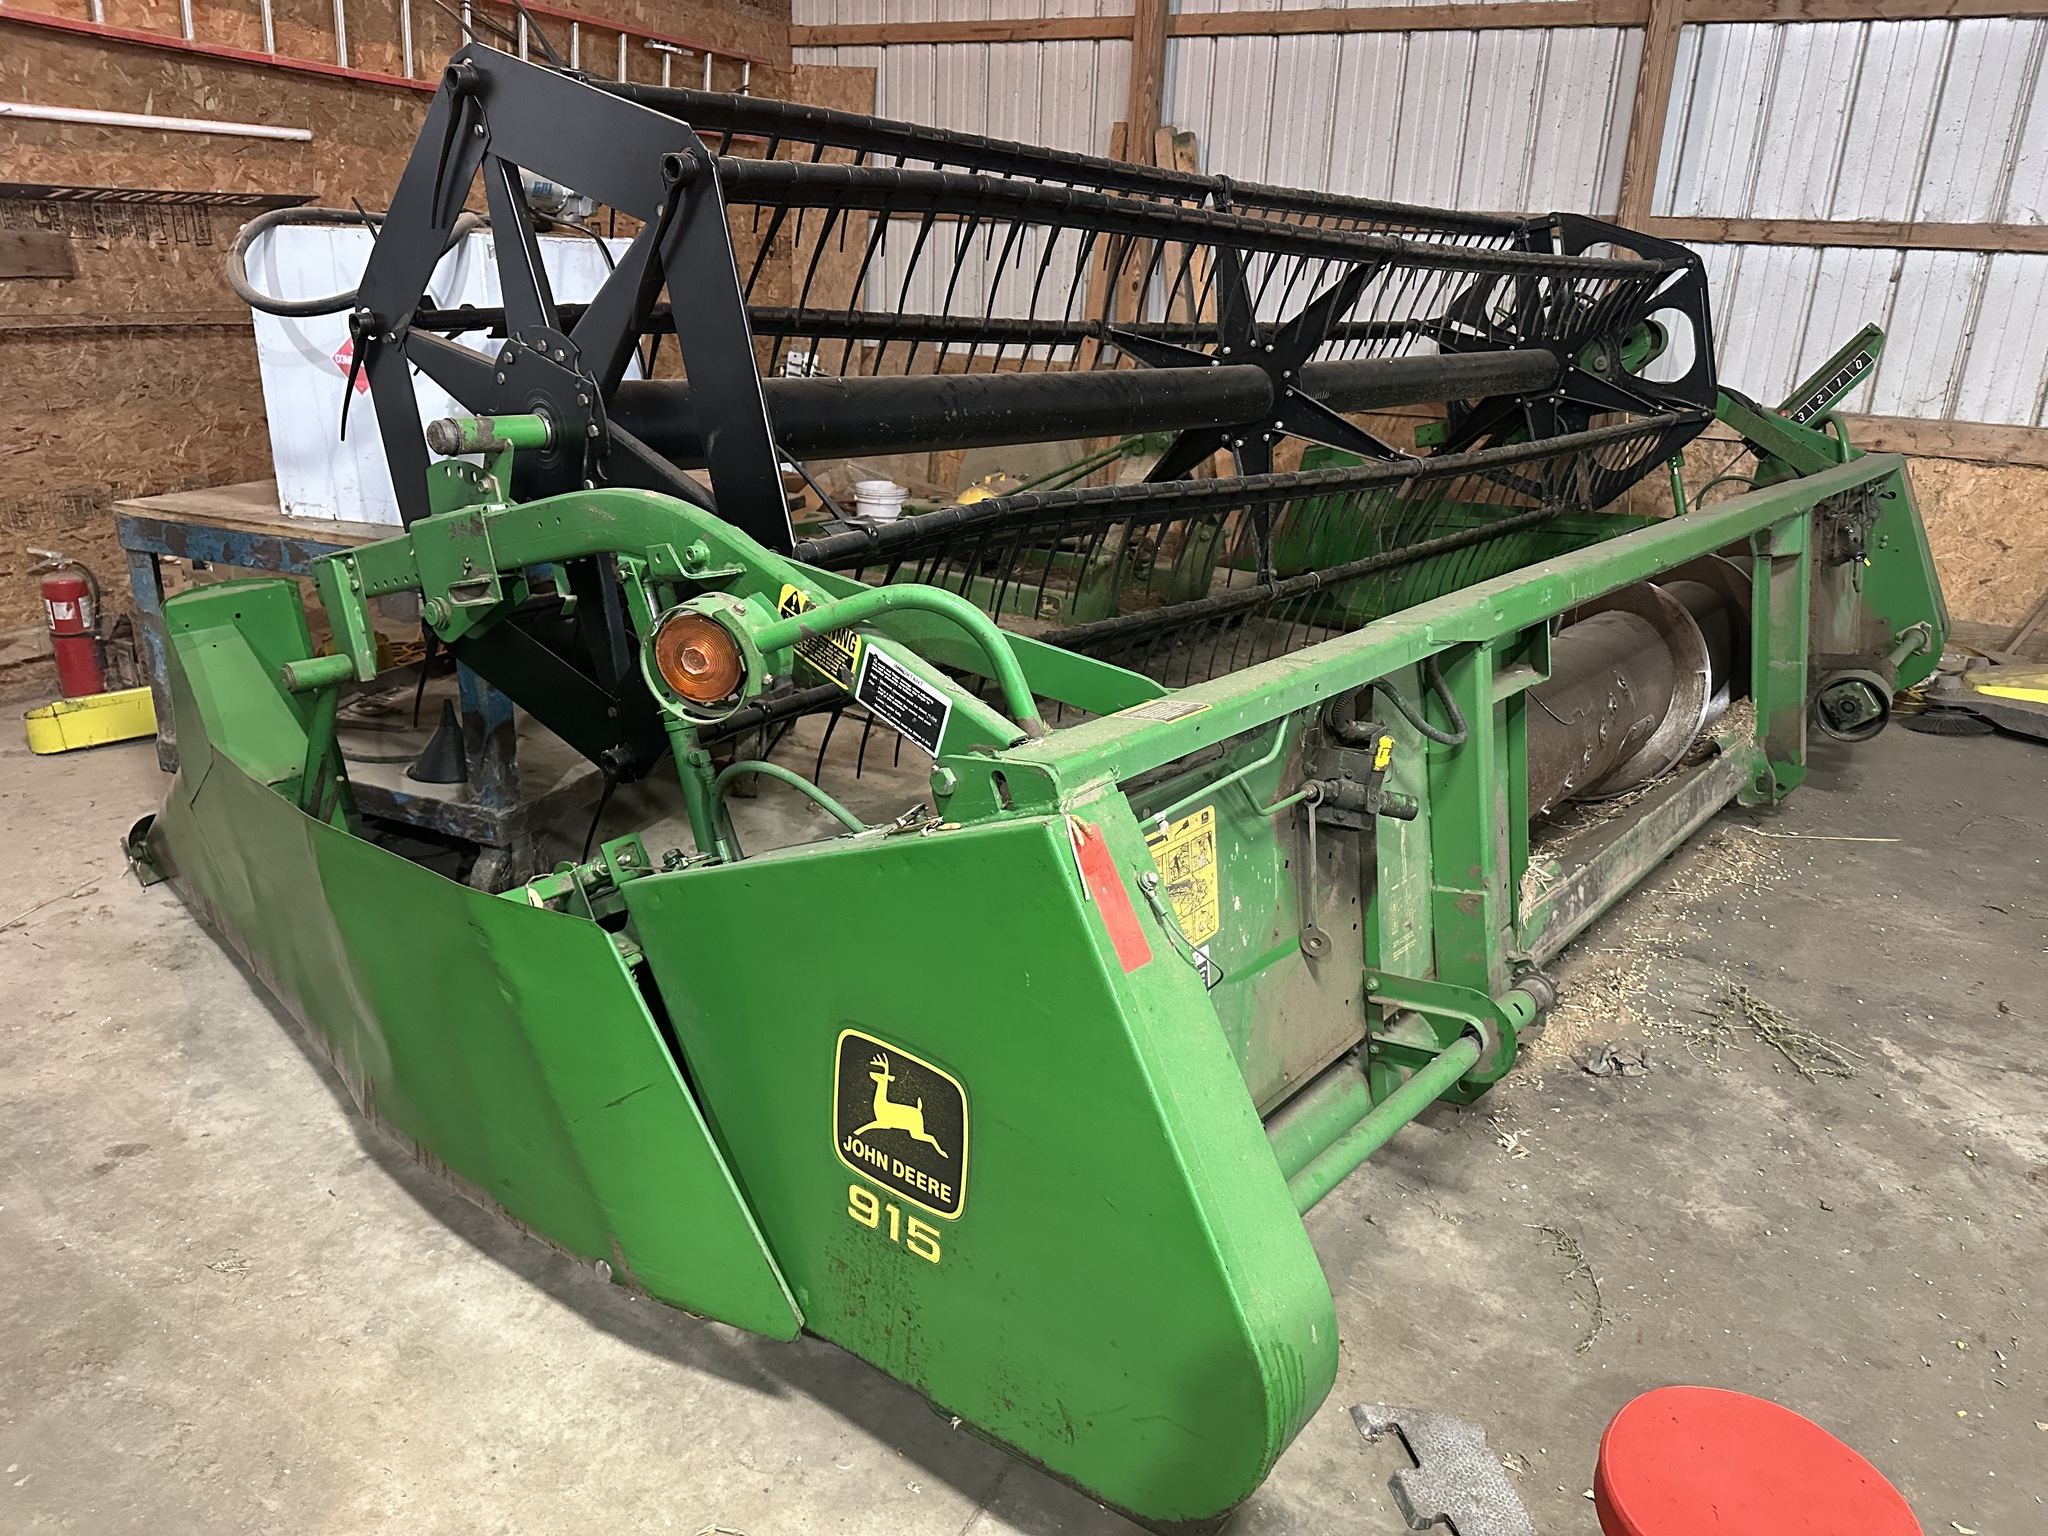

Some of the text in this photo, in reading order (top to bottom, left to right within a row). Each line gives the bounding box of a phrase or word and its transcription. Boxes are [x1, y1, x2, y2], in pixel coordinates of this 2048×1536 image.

[1797, 359, 1863, 422] 3 2 1 0
[893, 663, 924, 687] IMPORTANT
[843, 1135, 952, 1204] JOHN DEERE
[847, 1183, 942, 1265] 915
